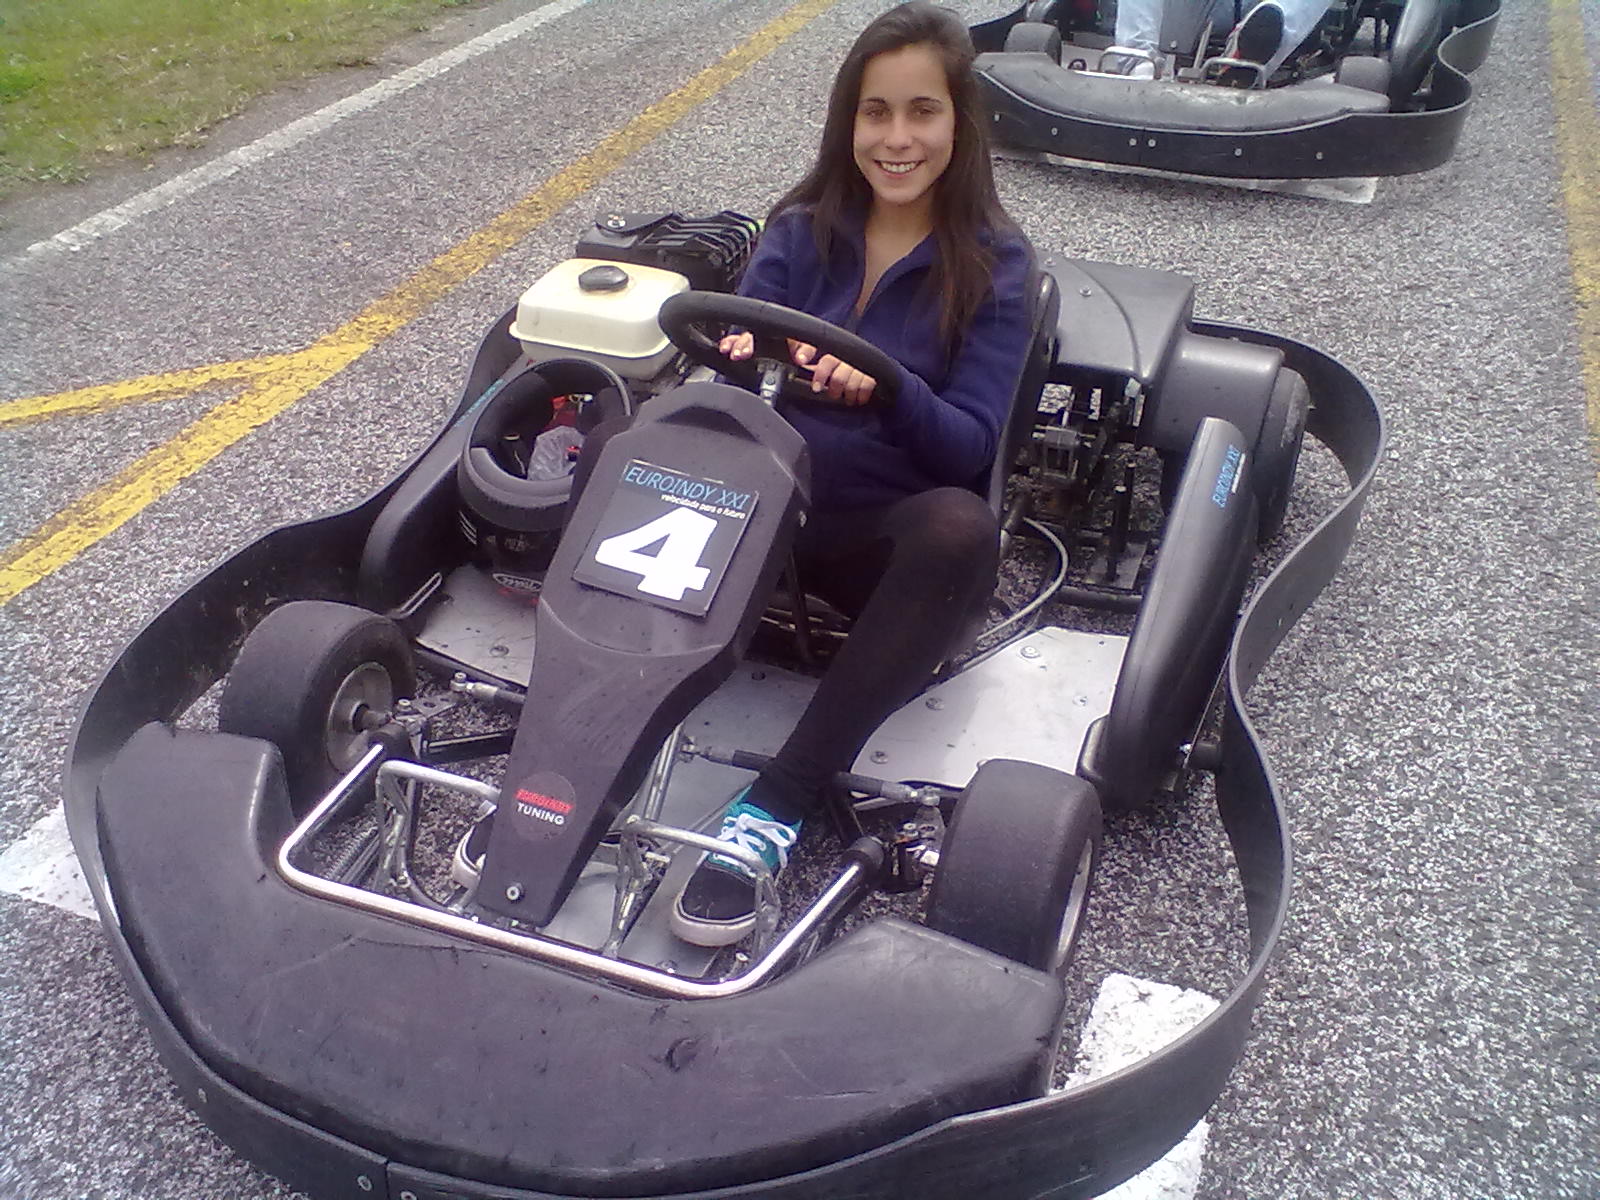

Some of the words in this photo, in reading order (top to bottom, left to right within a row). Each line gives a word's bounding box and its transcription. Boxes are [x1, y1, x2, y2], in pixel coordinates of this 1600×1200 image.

[625, 466, 717, 501] EUROINDY
[715, 489, 750, 510] XXI
[595, 506, 718, 601] 4
[517, 802, 565, 826] TUNING
